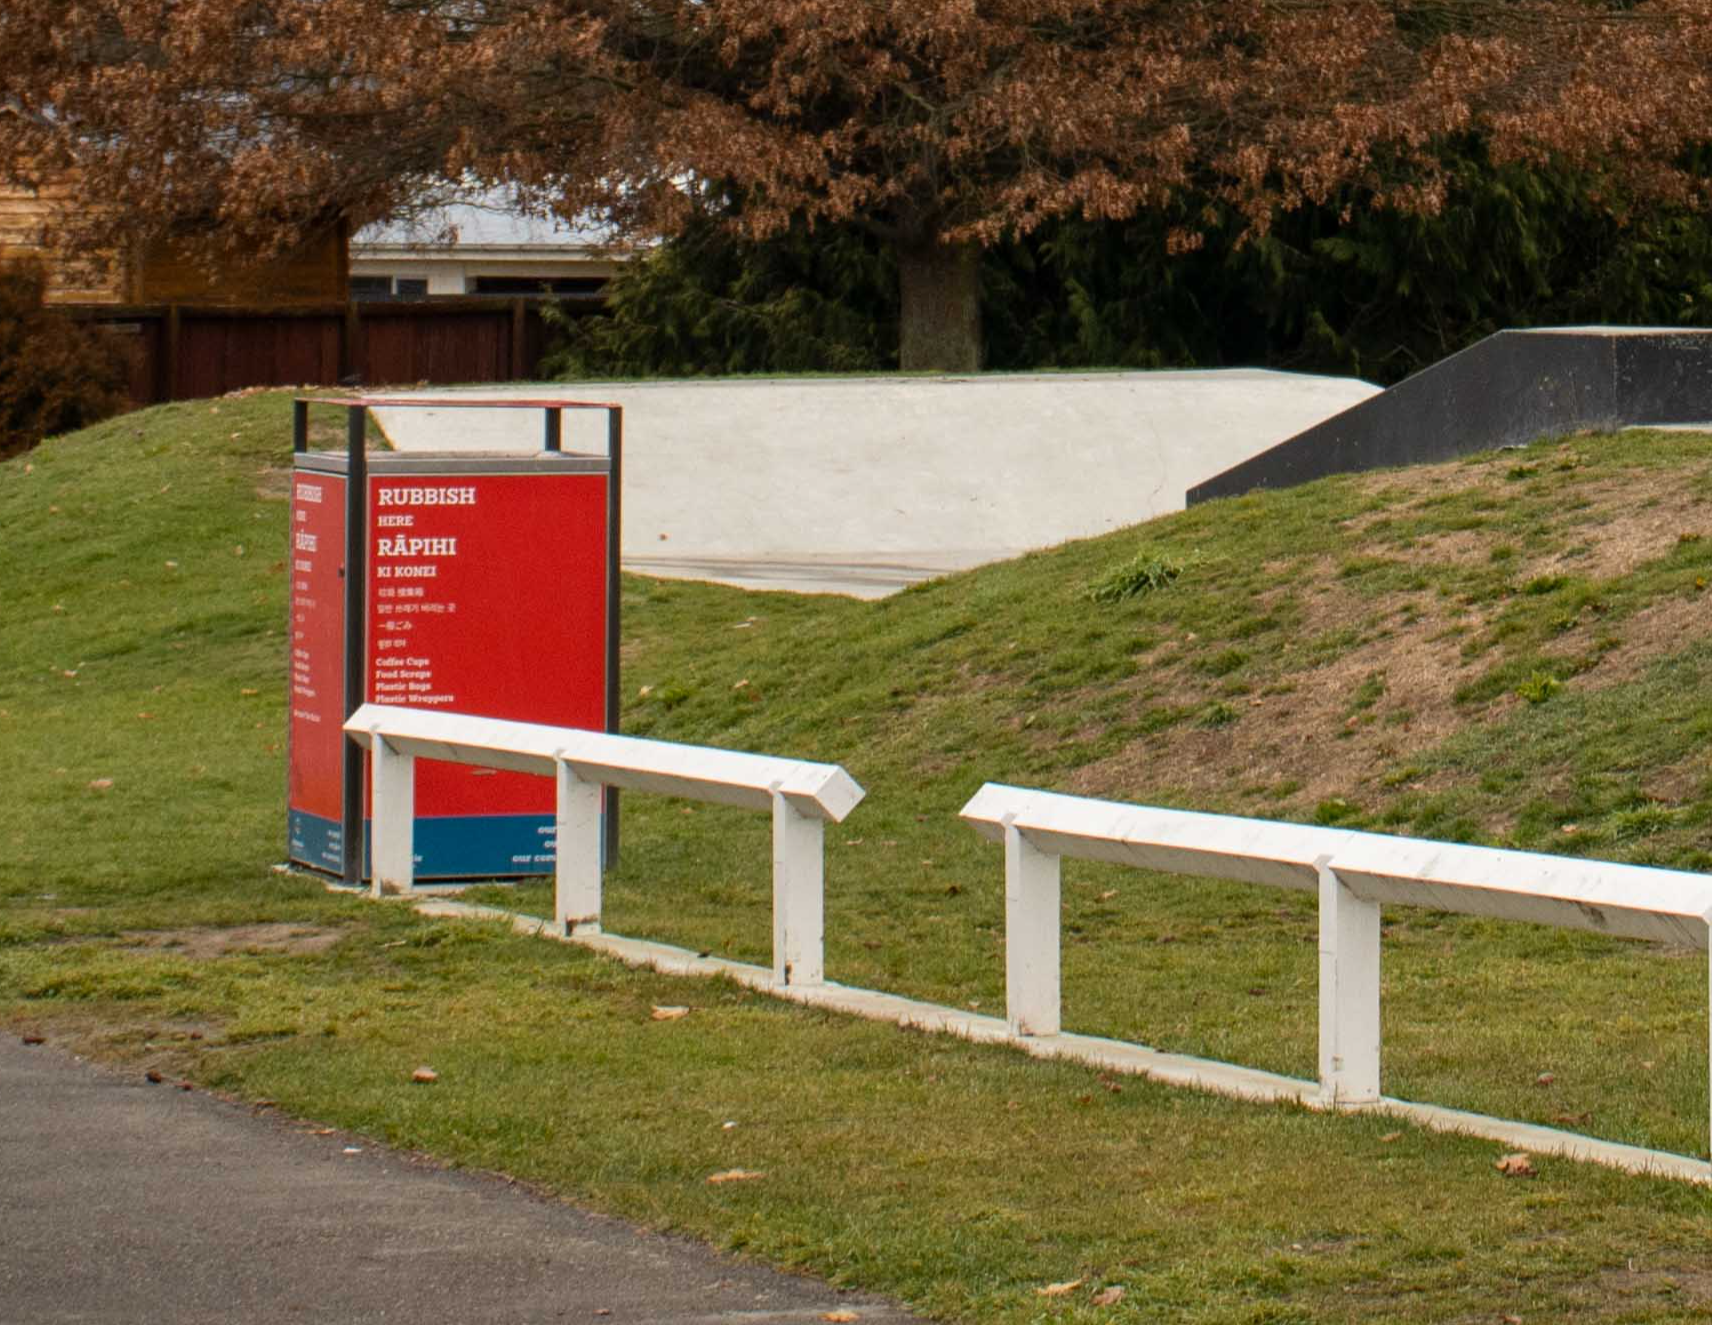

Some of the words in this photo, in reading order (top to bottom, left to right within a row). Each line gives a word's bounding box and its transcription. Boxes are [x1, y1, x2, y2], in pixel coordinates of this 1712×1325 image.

[378, 487, 476, 506] RUBBISH
[377, 515, 414, 527] HERE
[377, 534, 457, 556] RĀPIHI
[376, 565, 392, 578] KI
[394, 565, 437, 578] KONEI
[375, 657, 404, 667] Coffee
